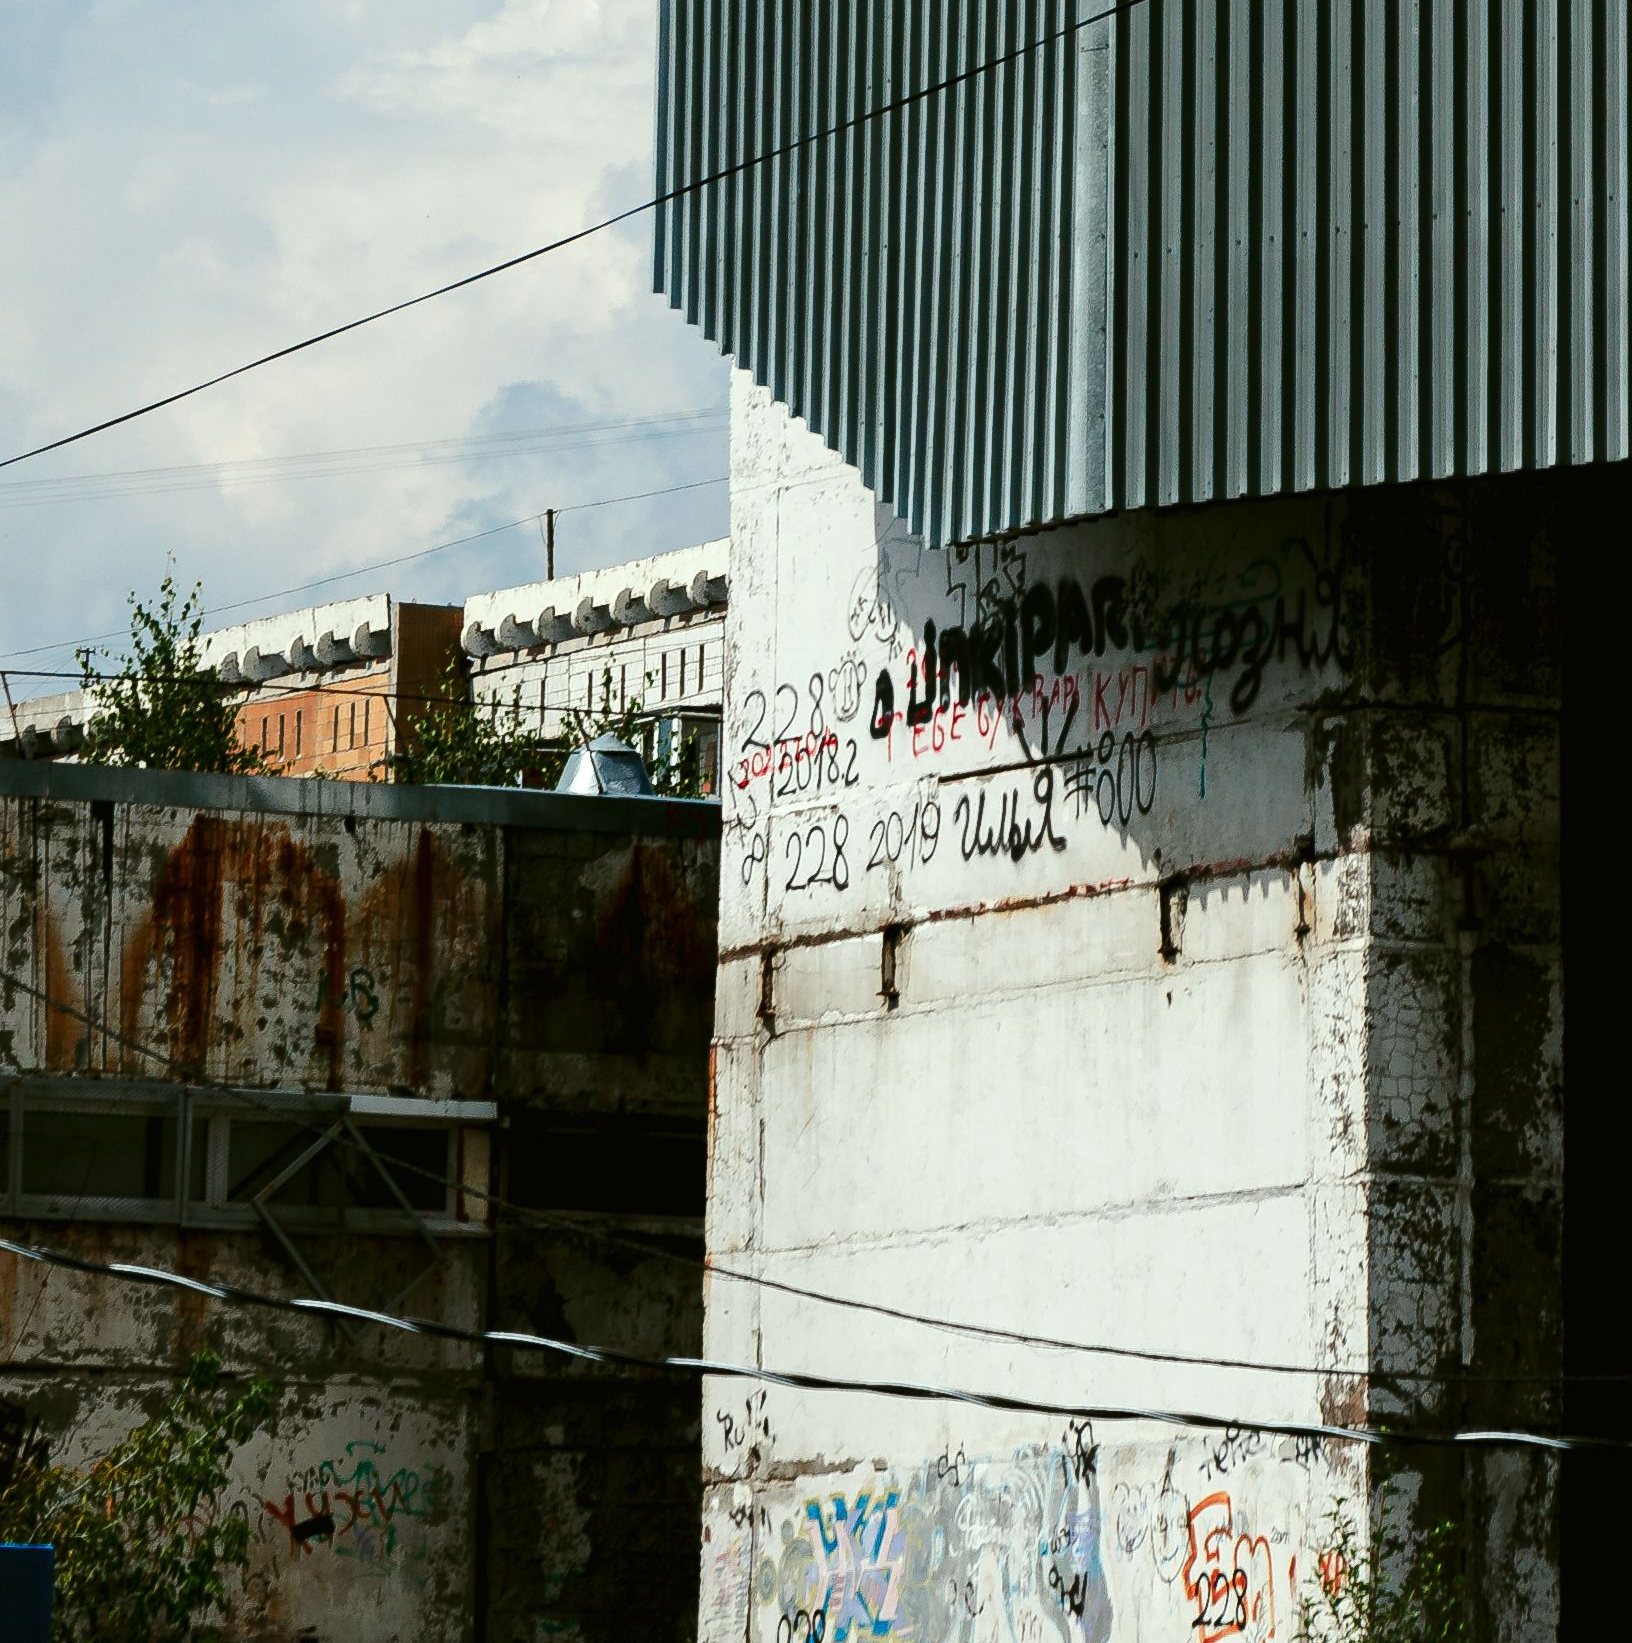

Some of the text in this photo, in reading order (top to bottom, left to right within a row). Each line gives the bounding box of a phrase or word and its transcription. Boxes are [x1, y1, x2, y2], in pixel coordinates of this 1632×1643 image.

[742, 672, 824, 753] 228
[785, 813, 849, 891] 228
[866, 800, 941, 873] 2019
[1191, 1567, 1247, 1632] 228
